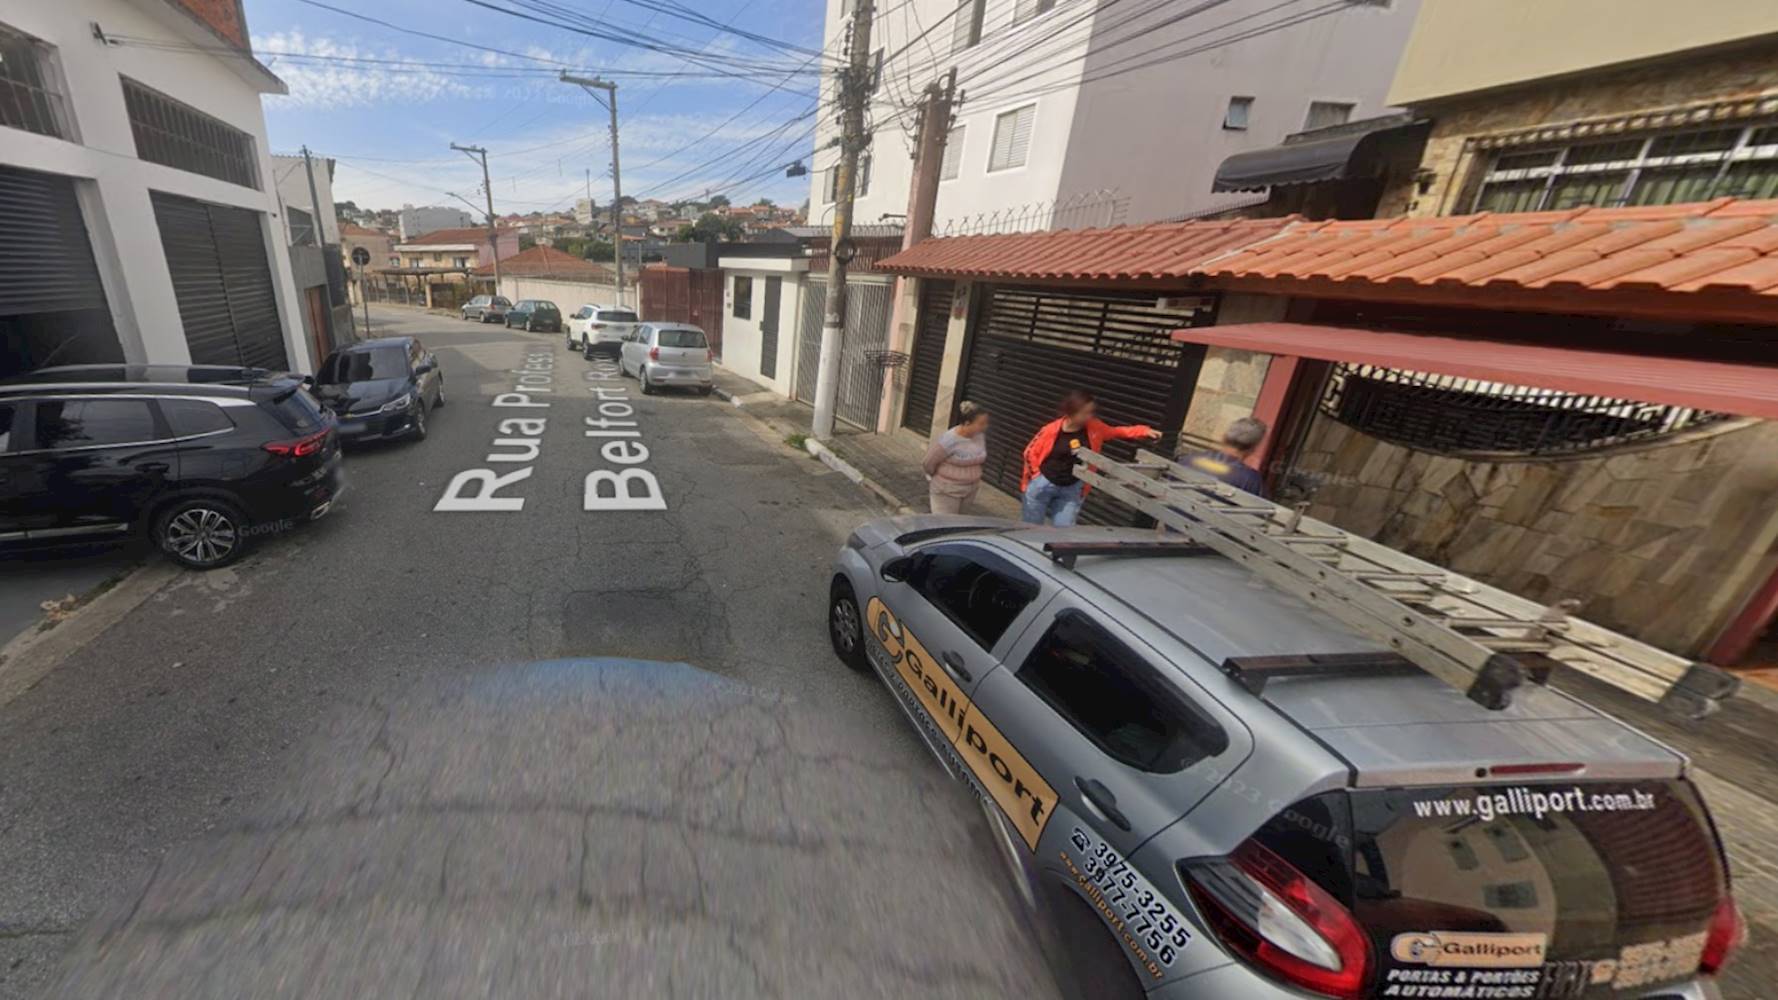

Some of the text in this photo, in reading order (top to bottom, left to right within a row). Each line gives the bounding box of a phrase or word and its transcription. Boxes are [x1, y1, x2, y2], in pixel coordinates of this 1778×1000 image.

[905, 648, 1045, 827] Galliport
[1412, 785, 1656, 823] www.galliport.com.br
[1084, 856, 1177, 966] 3977-7756
[1094, 842, 1192, 949] 3975-3255
[1387, 969, 1450, 984] PORTAS
[1443, 941, 1541, 958] Galliport
